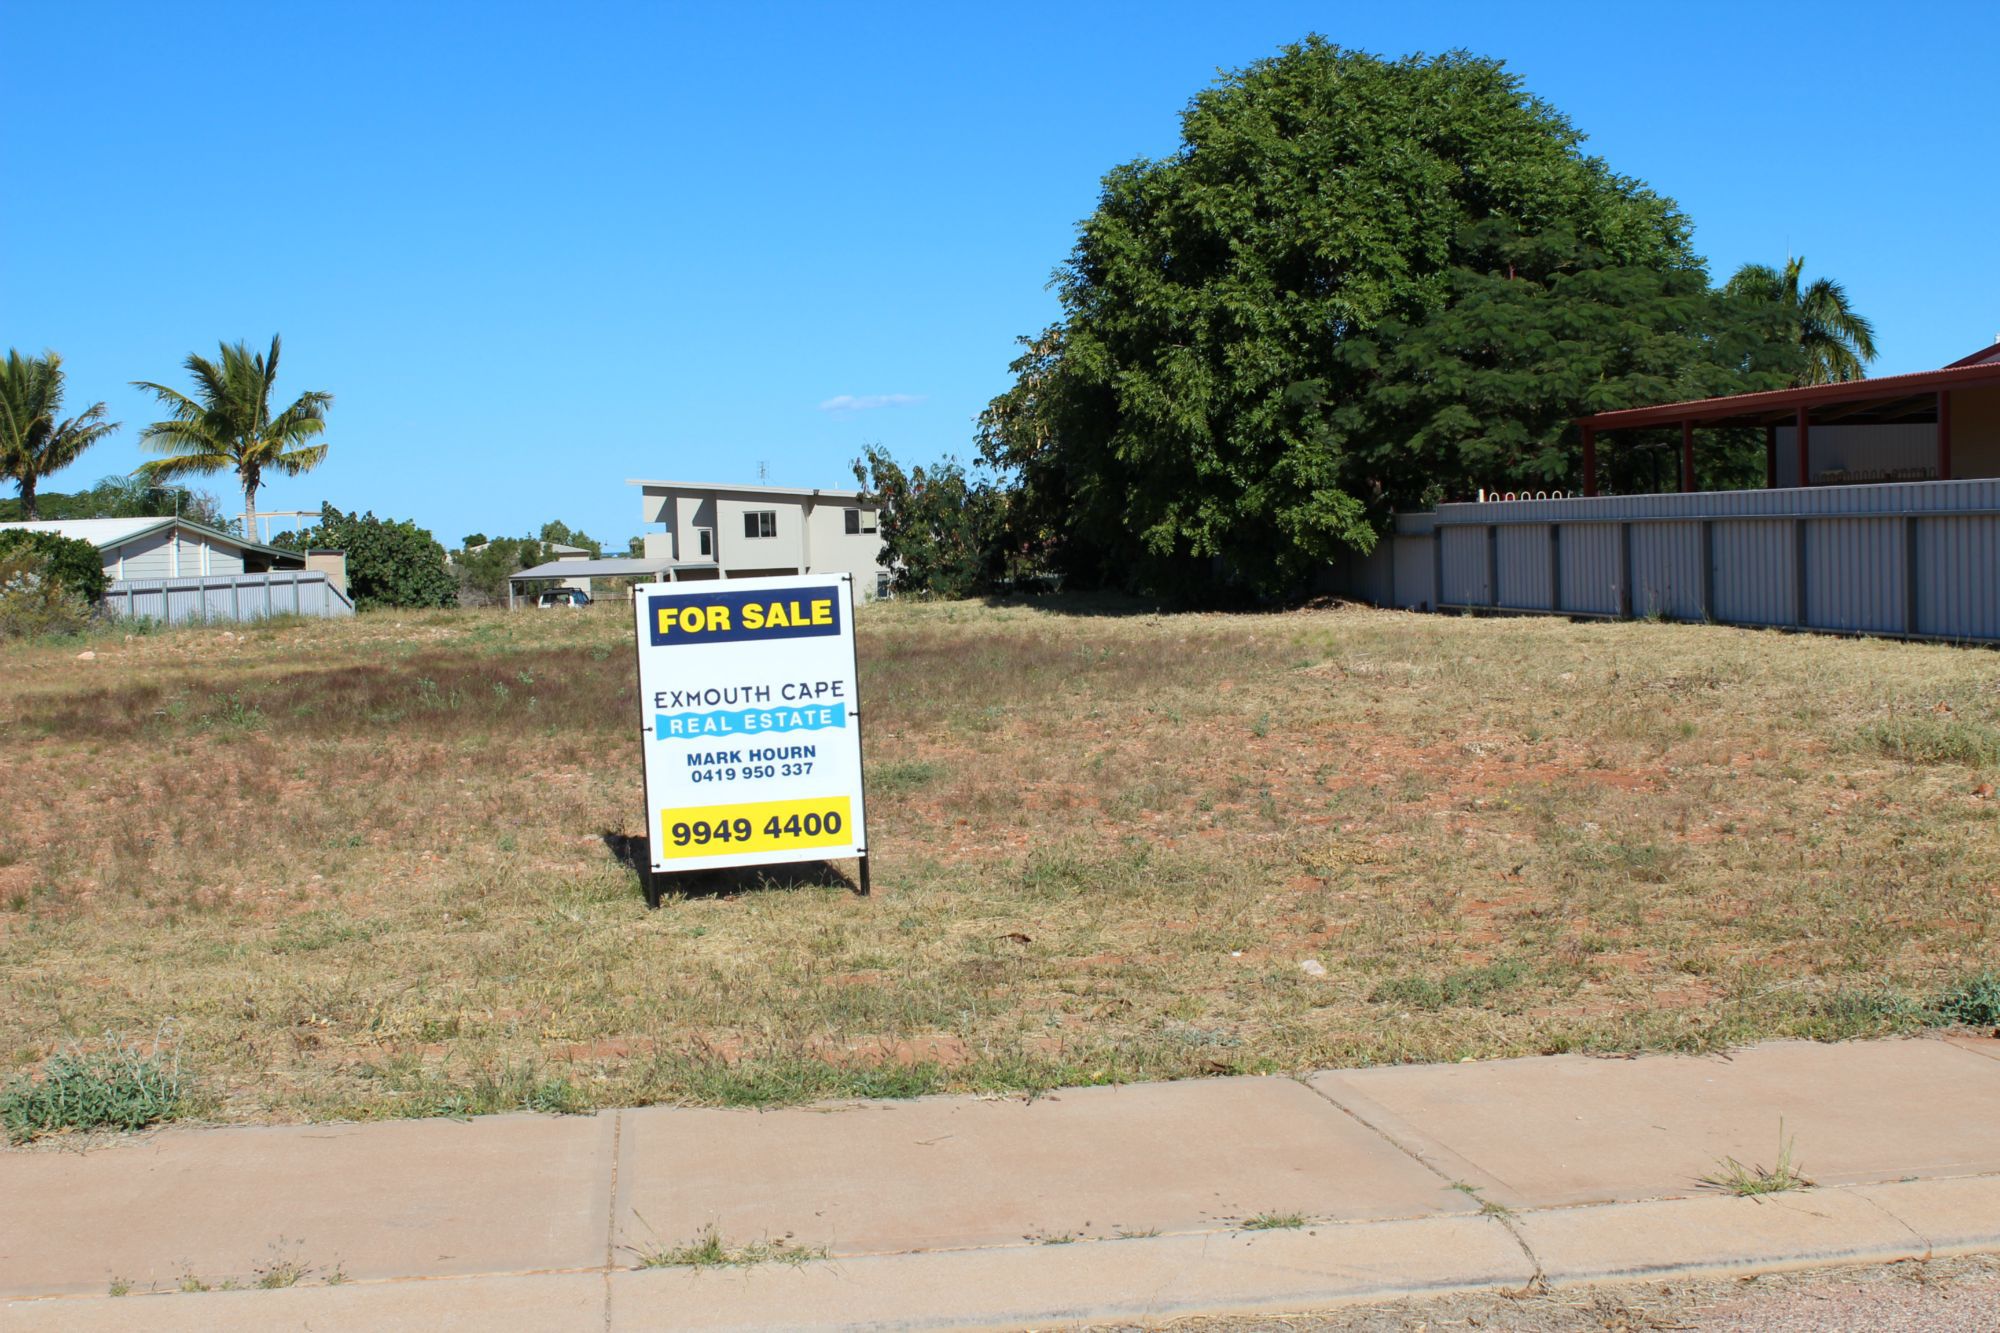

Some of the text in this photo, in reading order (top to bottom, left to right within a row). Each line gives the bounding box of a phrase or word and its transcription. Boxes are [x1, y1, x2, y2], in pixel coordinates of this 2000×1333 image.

[658, 600, 833, 634] FOR SALE
[654, 680, 844, 708] EXMOUTH CAPE
[670, 709, 832, 734] REAL ESTATE
[687, 745, 816, 766] MARK HOURN
[691, 762, 813, 783] 0419 950 337
[672, 811, 842, 846] 9949 4400
